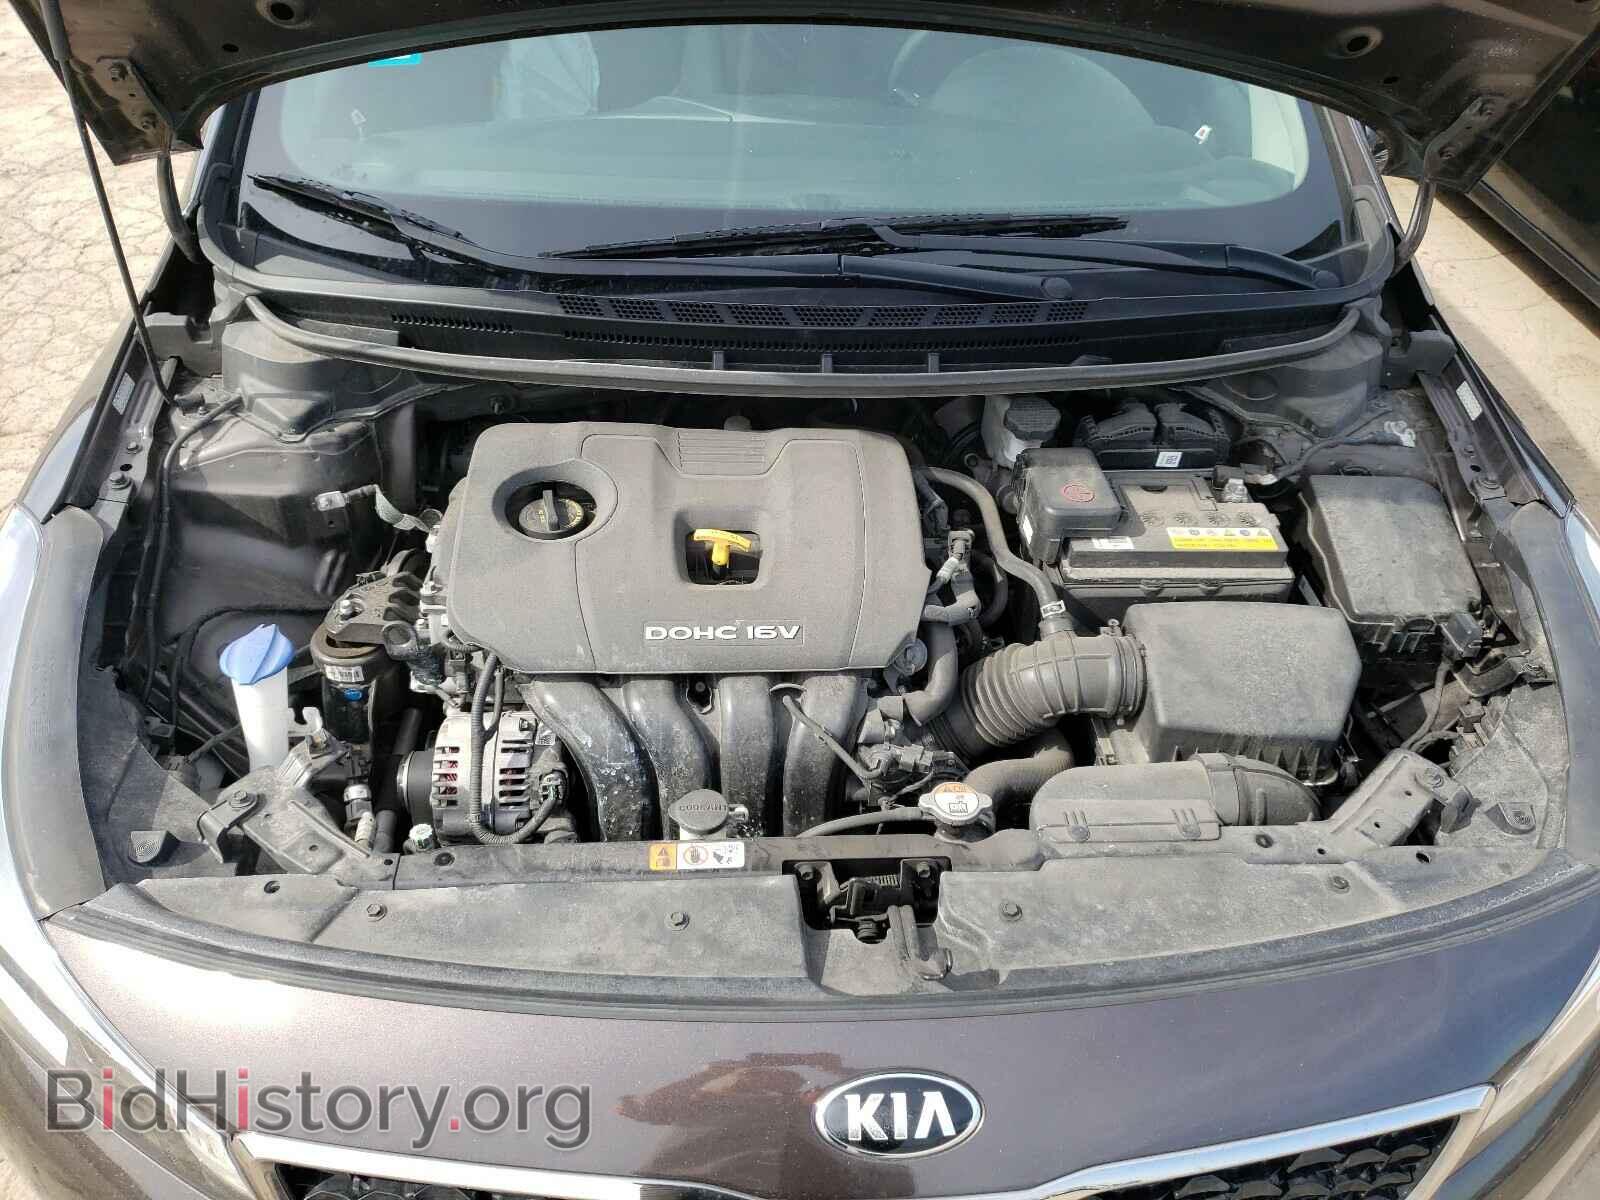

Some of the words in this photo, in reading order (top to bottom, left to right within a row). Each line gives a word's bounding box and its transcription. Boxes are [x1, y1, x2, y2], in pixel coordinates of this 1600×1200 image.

[645, 625, 737, 640] DOHC
[746, 625, 800, 639] 16V
[844, 1091, 957, 1141] KIA
